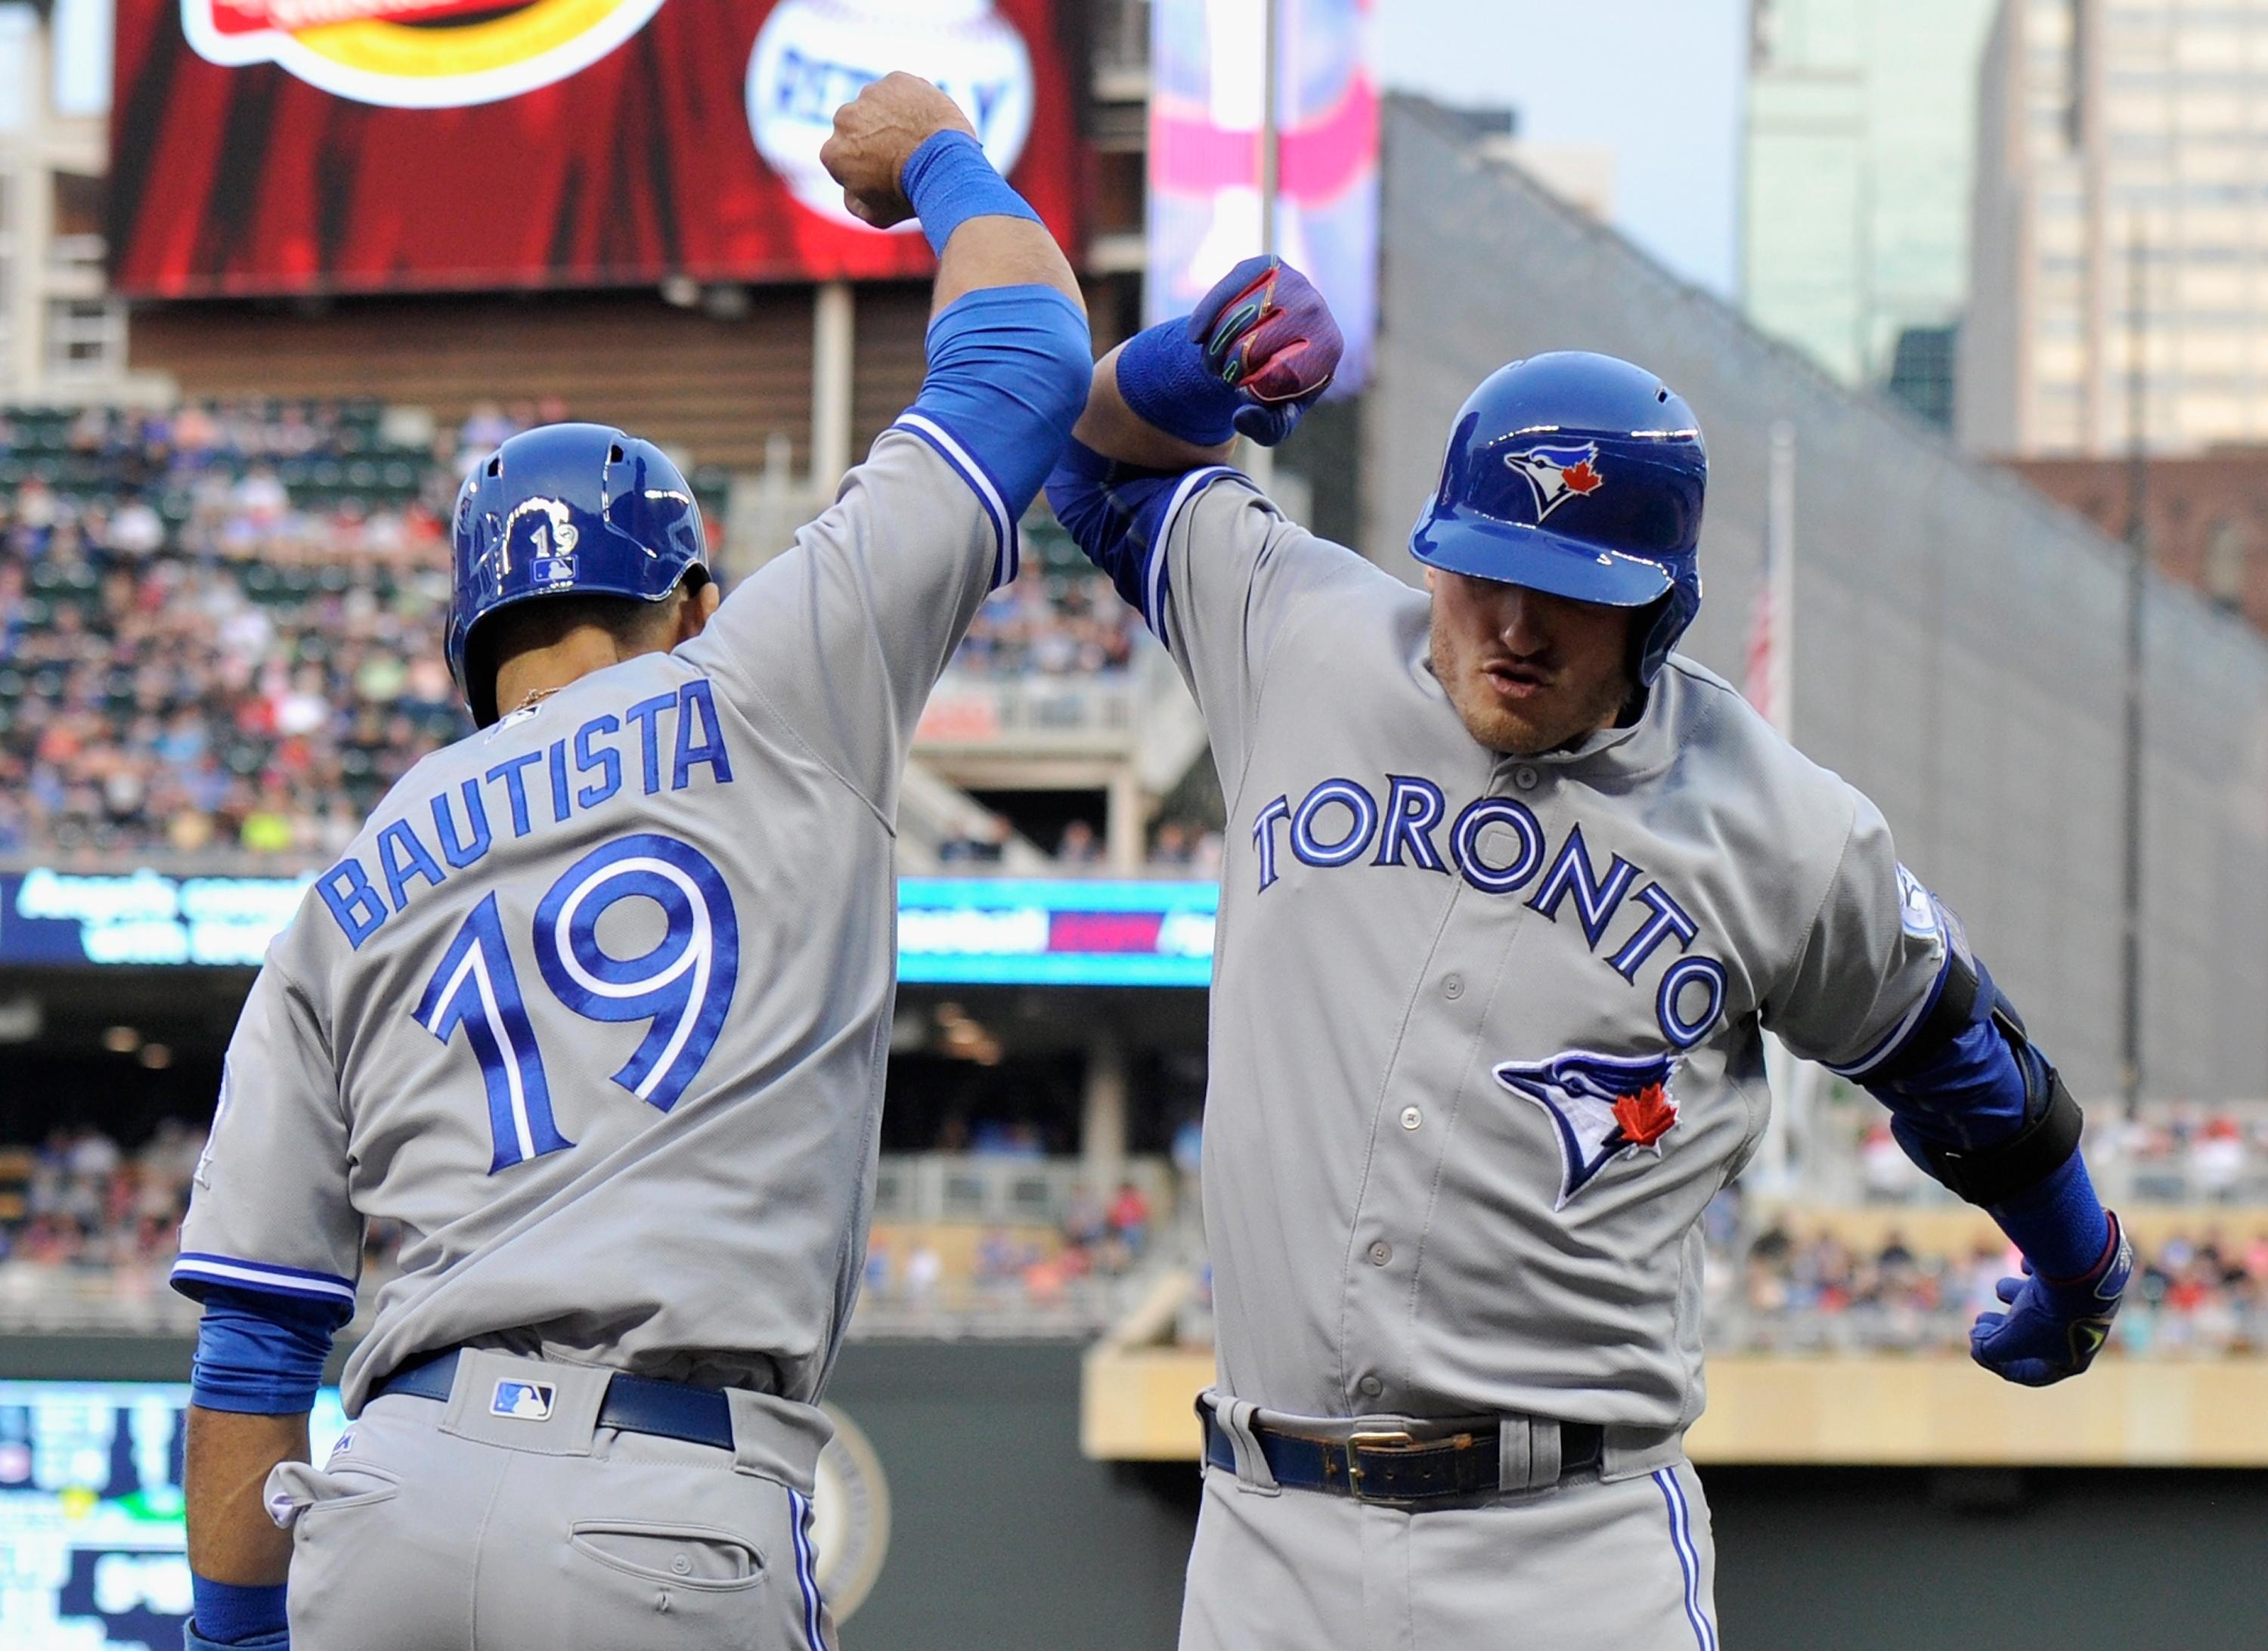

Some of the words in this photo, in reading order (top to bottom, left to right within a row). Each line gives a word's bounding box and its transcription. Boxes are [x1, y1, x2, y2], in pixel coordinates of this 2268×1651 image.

[529, 523, 579, 559] 19
[314, 678, 733, 951] BAUTISTA
[1252, 773, 1728, 1049] TORONTO
[411, 833, 739, 1176] 19
